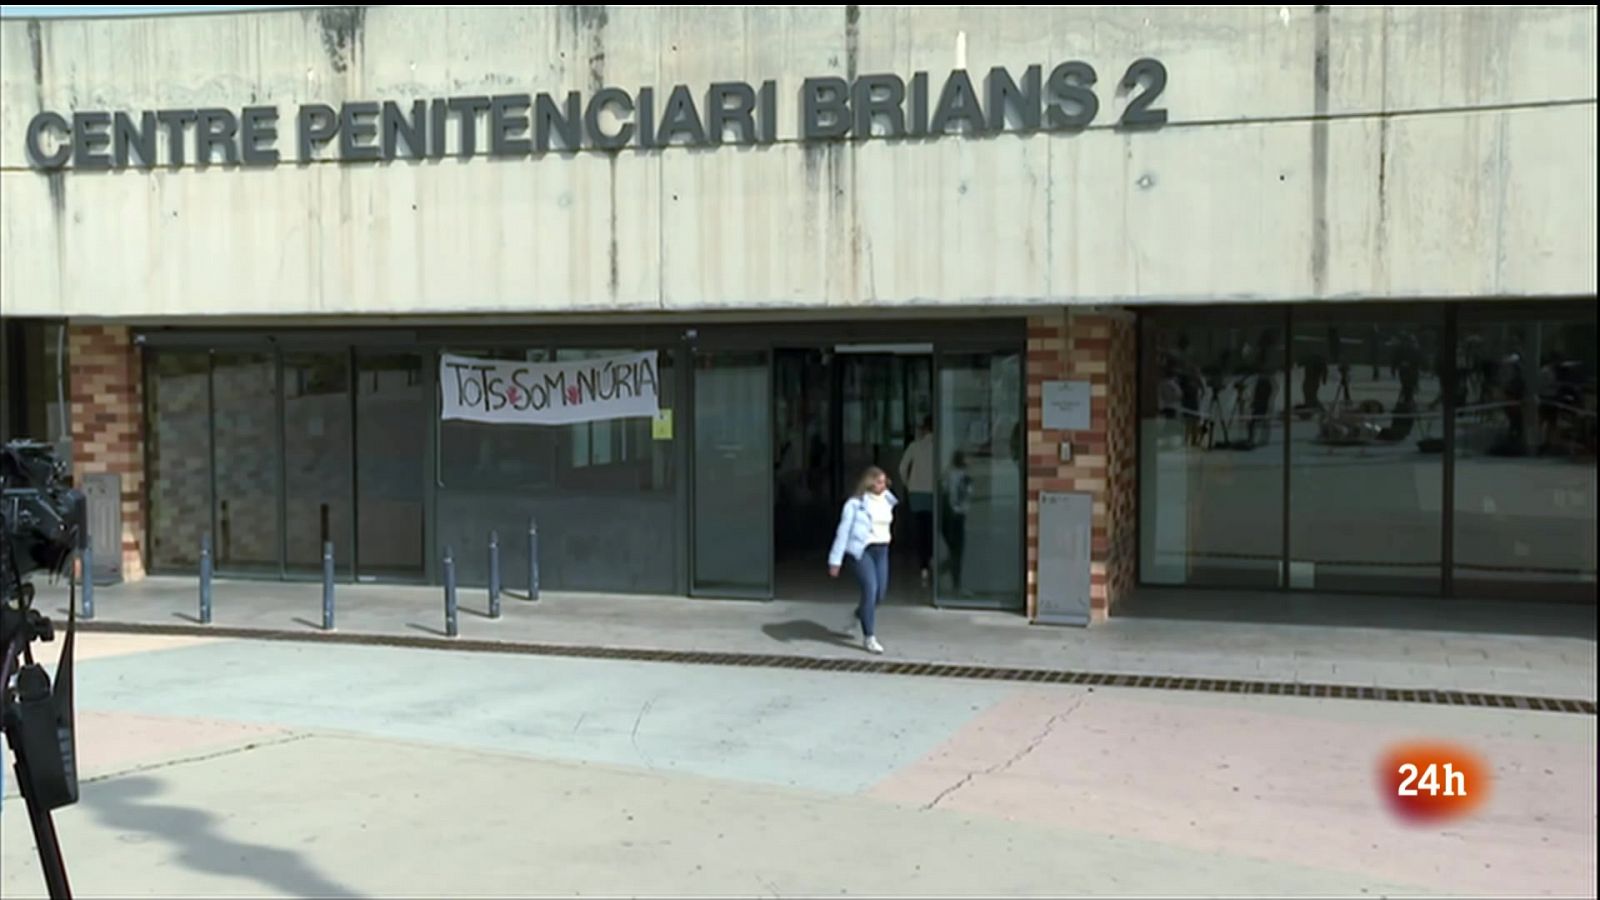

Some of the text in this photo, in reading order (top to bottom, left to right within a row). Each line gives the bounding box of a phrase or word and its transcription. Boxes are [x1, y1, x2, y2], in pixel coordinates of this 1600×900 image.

[26, 58, 1168, 170] CENTRE PENITENCIARI BRIANS 2
[576, 357, 658, 405] NÚRIA
